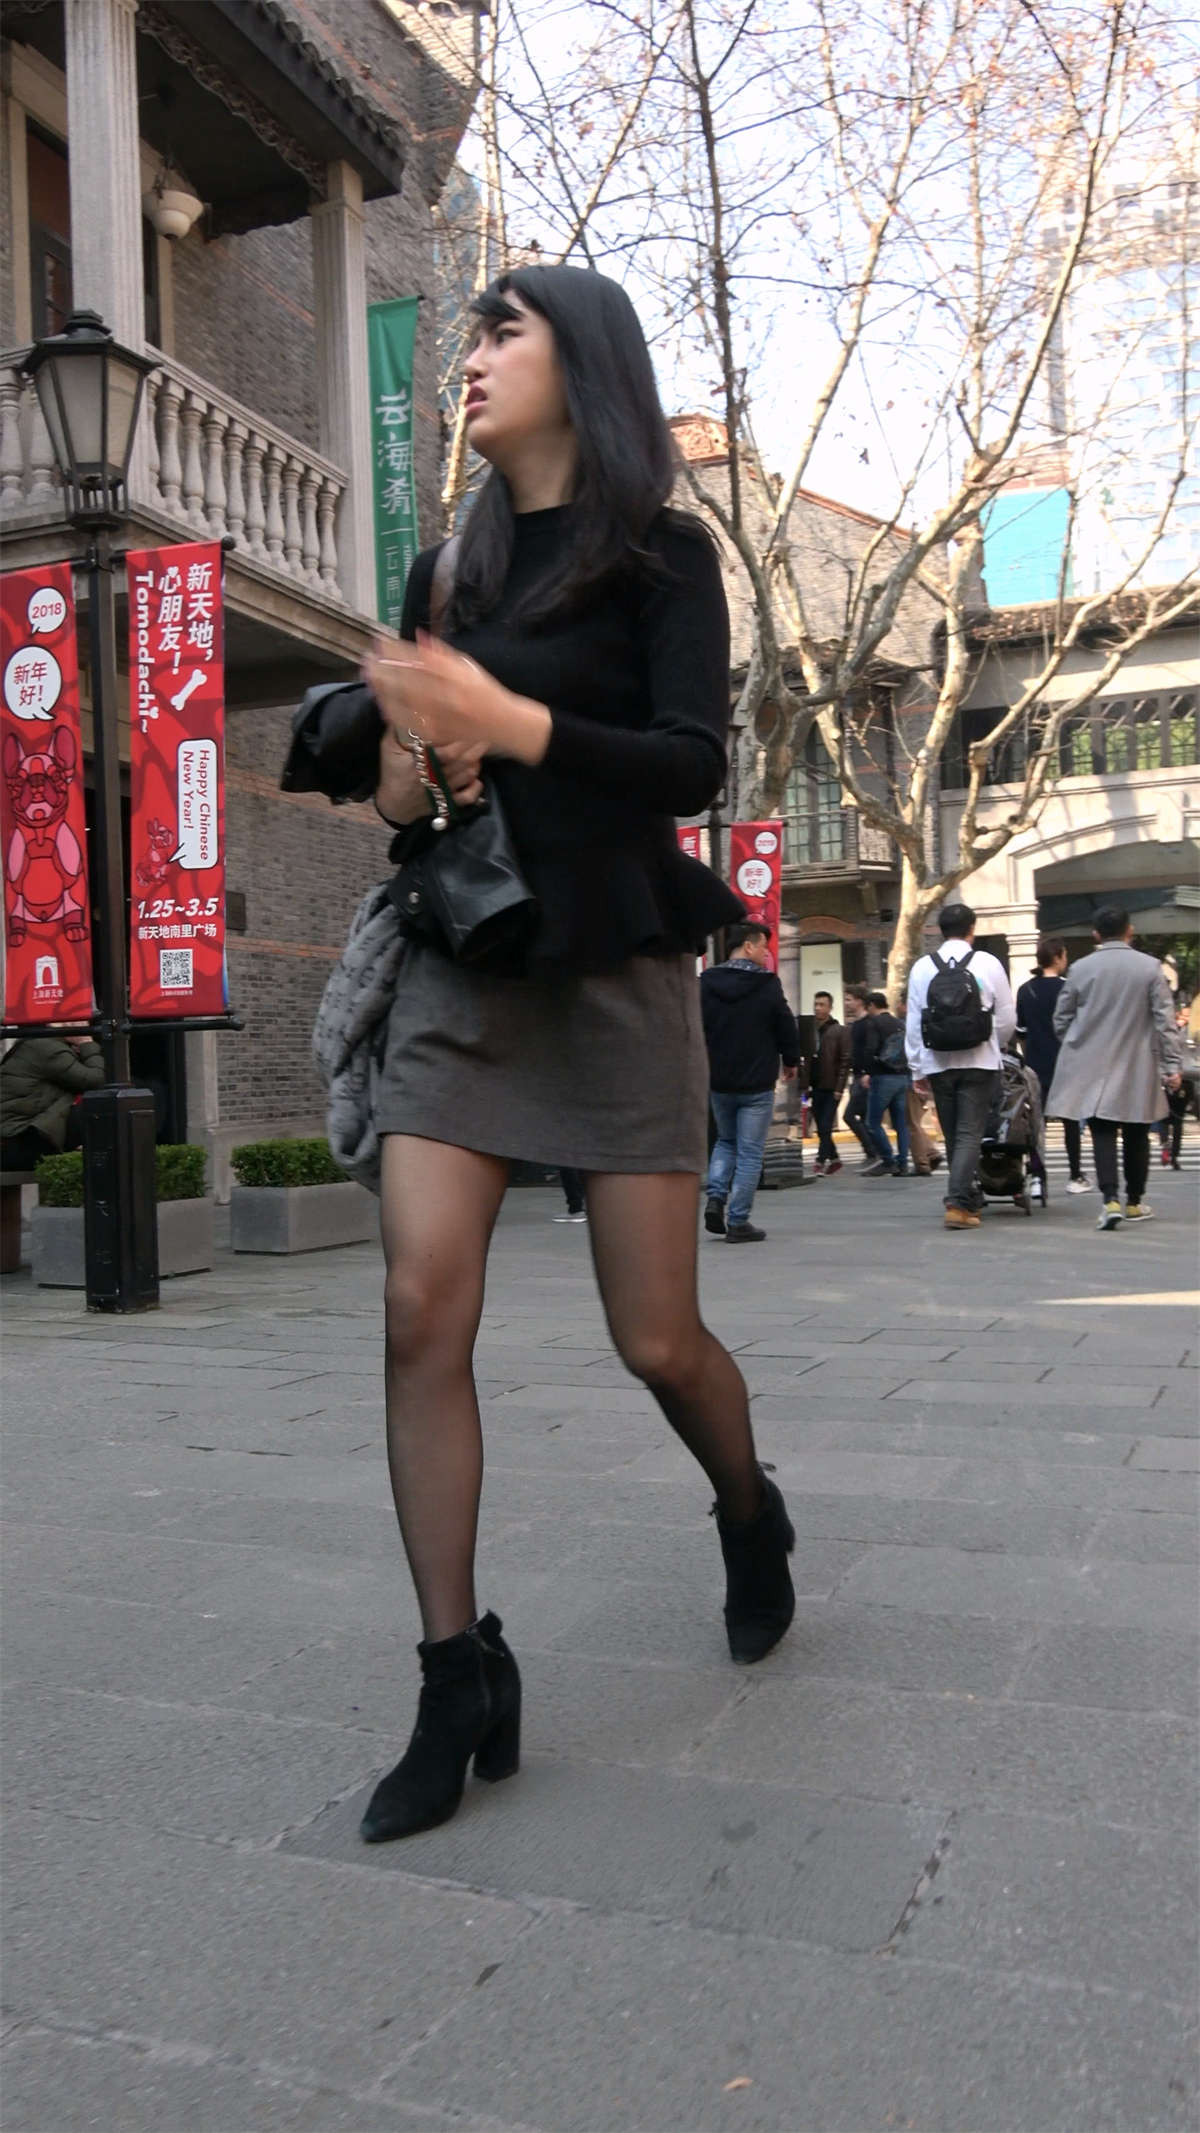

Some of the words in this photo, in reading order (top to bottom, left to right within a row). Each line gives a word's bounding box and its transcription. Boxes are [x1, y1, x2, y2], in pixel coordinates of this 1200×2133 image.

[32, 602, 62, 619] 2018
[13, 661, 48, 685] 新年
[183, 750, 194, 785] New
[196, 749, 210, 798] Happy
[183, 790, 195, 829] Year!
[199, 803, 211, 860] Chinese
[137, 897, 219, 919] 1.25~3.5
[137, 923, 217, 940] 新天地南里广场
